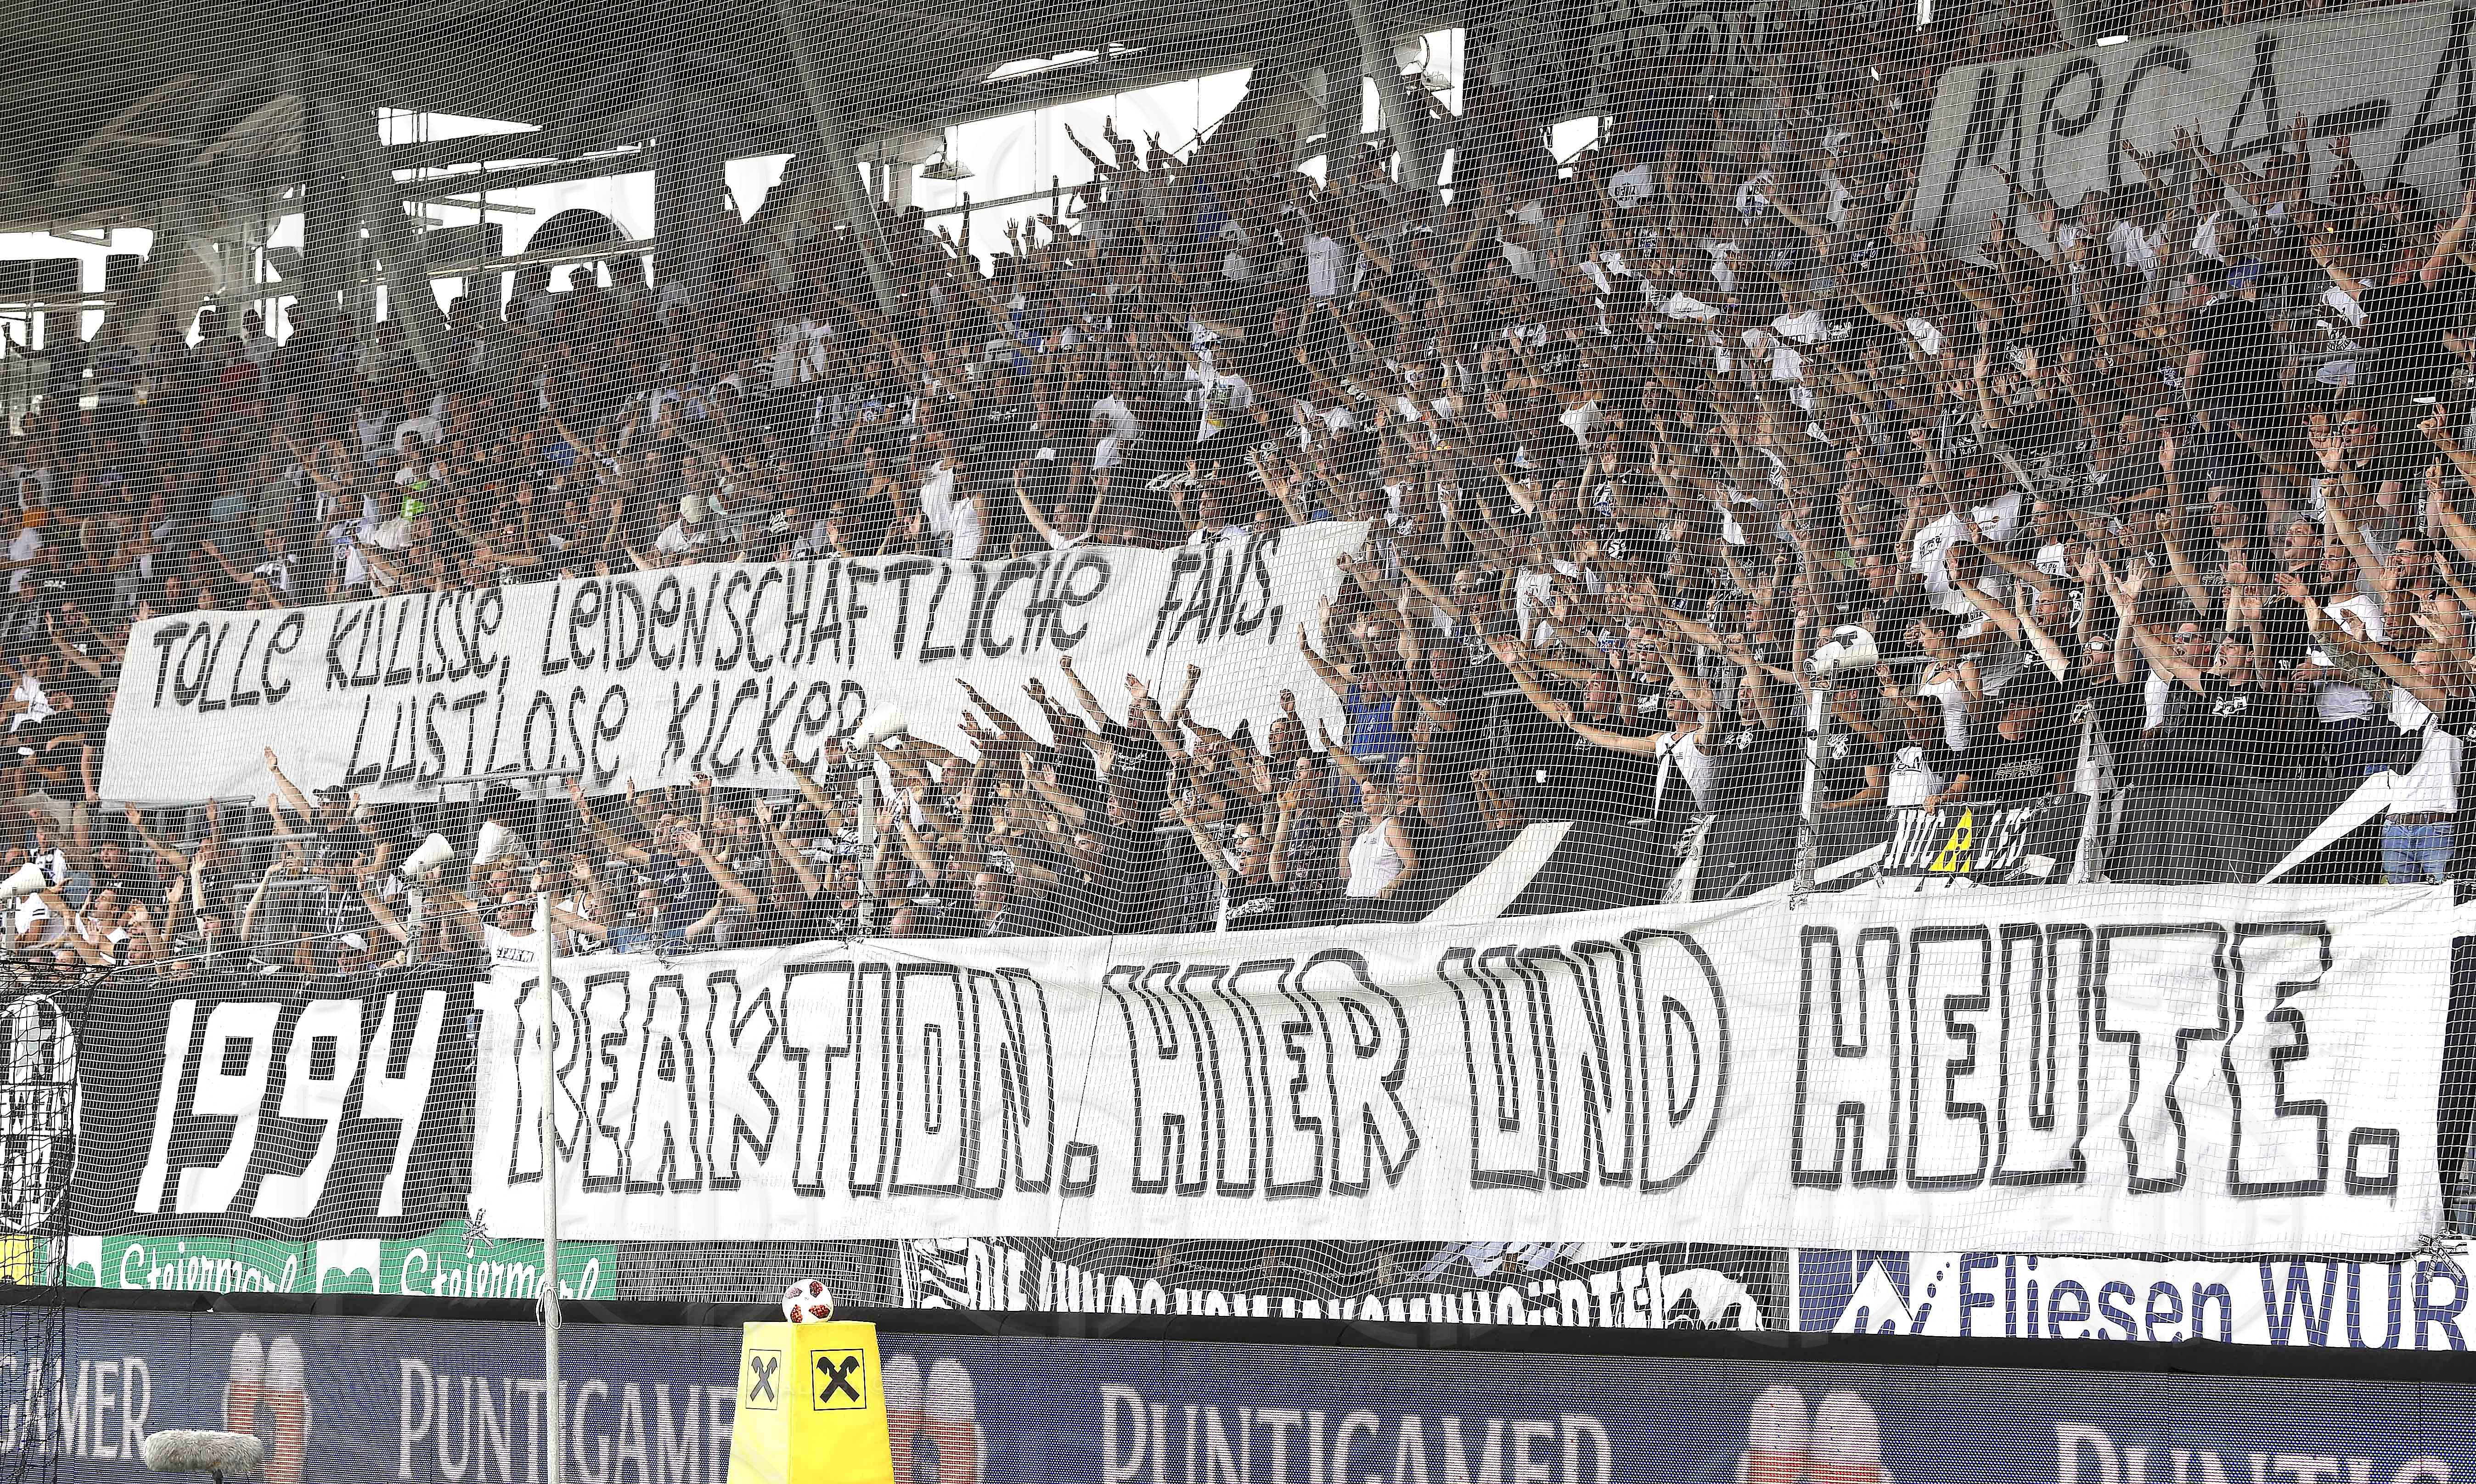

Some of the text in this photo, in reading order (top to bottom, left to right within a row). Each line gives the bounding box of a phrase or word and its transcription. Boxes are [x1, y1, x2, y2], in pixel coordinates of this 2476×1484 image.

[133, 990, 446, 1218] 1994
[507, 920, 2398, 1197] REAKTION. HIER UND HEUTE.
[1960, 1253, 2232, 1343] Fliesen
